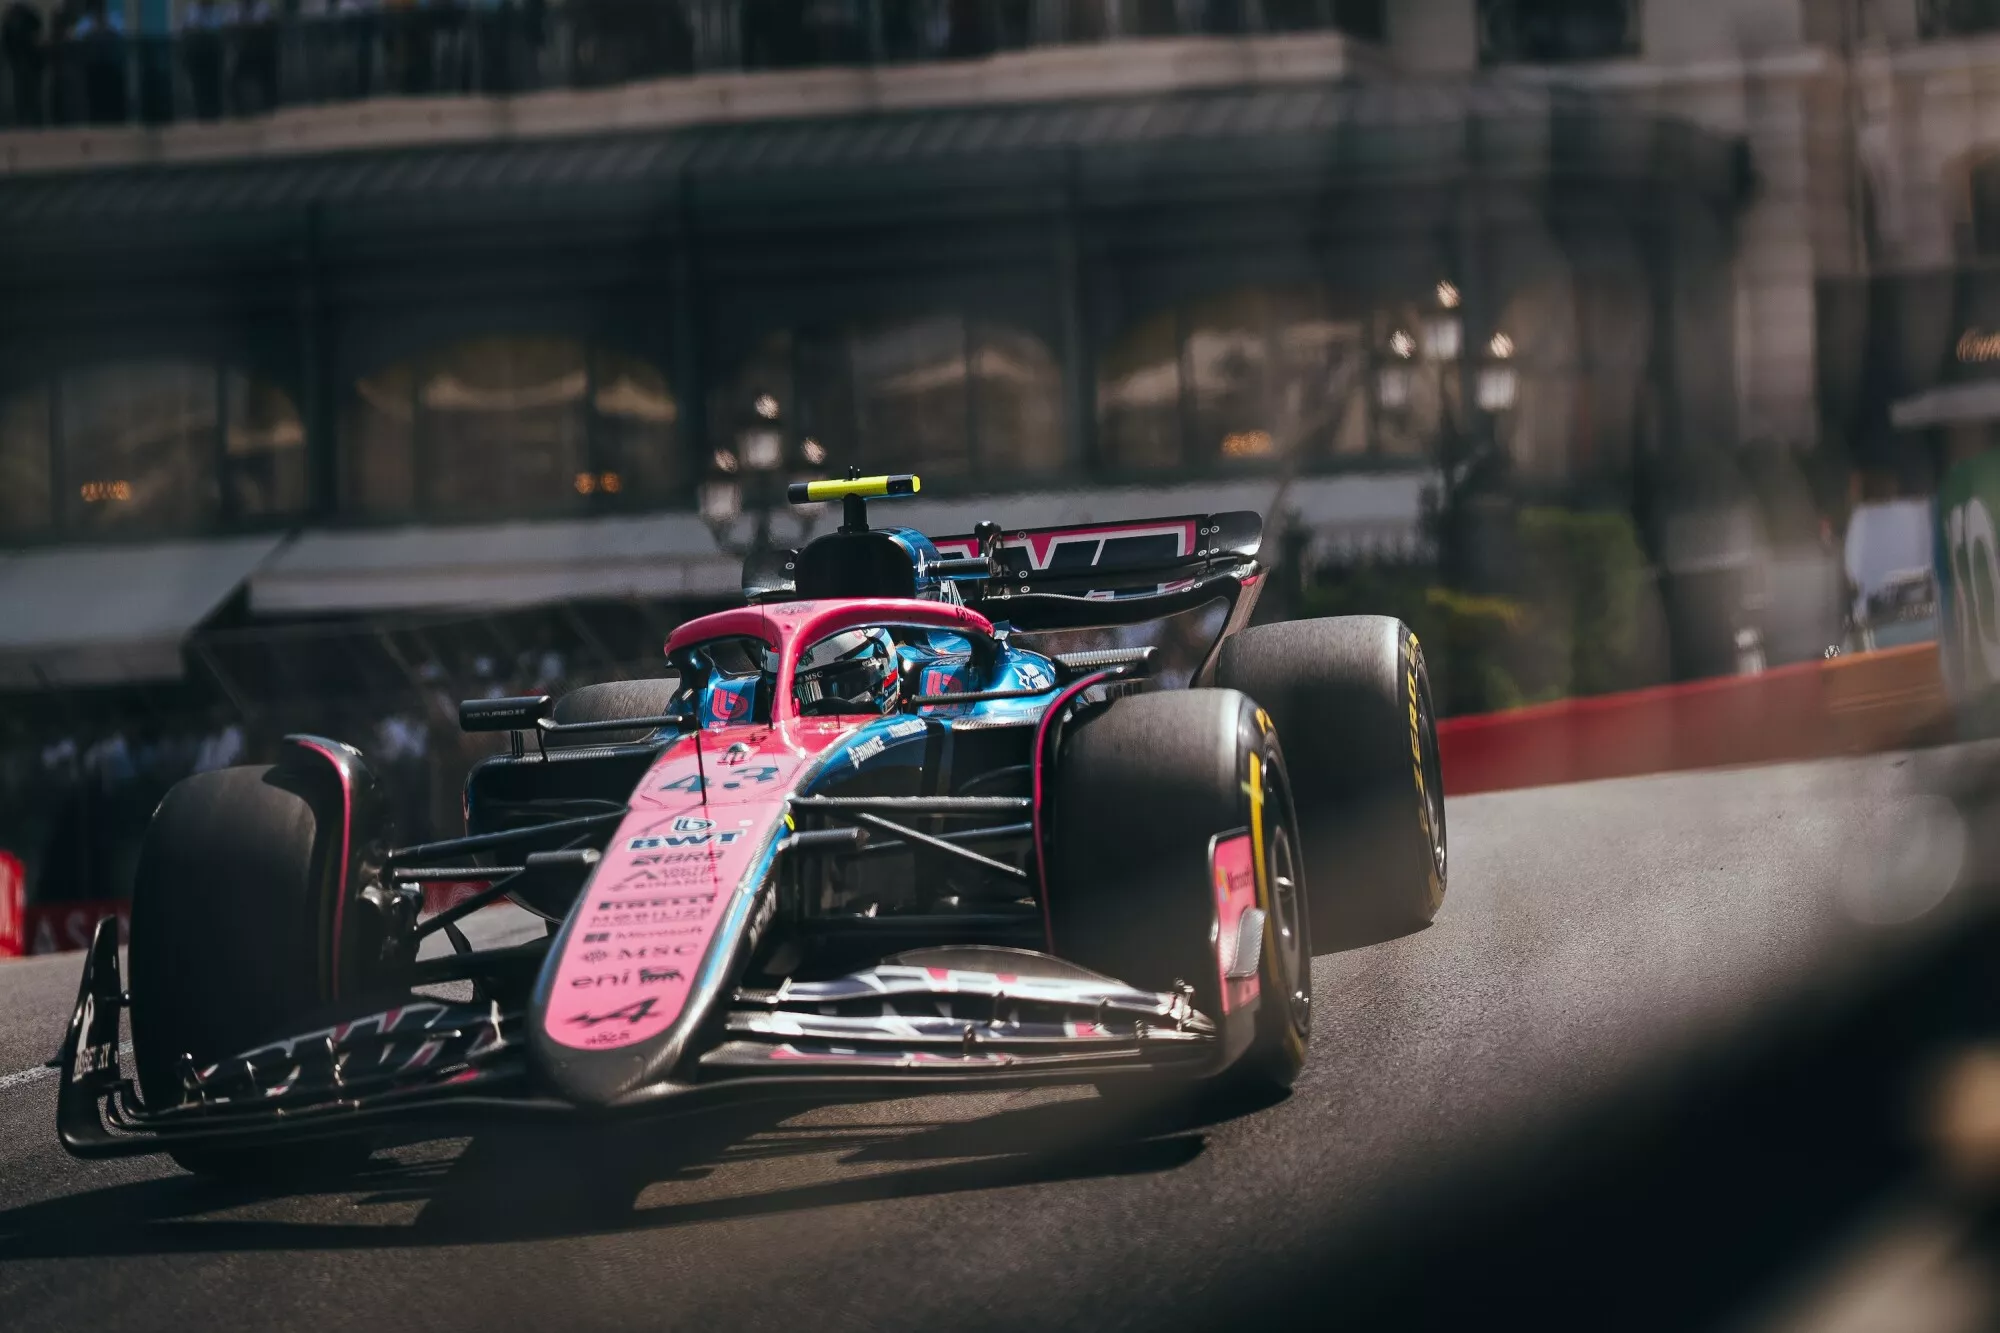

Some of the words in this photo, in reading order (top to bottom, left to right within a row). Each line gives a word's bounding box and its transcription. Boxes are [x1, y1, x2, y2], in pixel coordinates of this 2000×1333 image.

[804, 670, 823, 681] MSC
[660, 767, 779, 792] 43
[629, 830, 746, 850] BWT
[618, 943, 698, 960] MSC
[571, 969, 631, 988] eni
